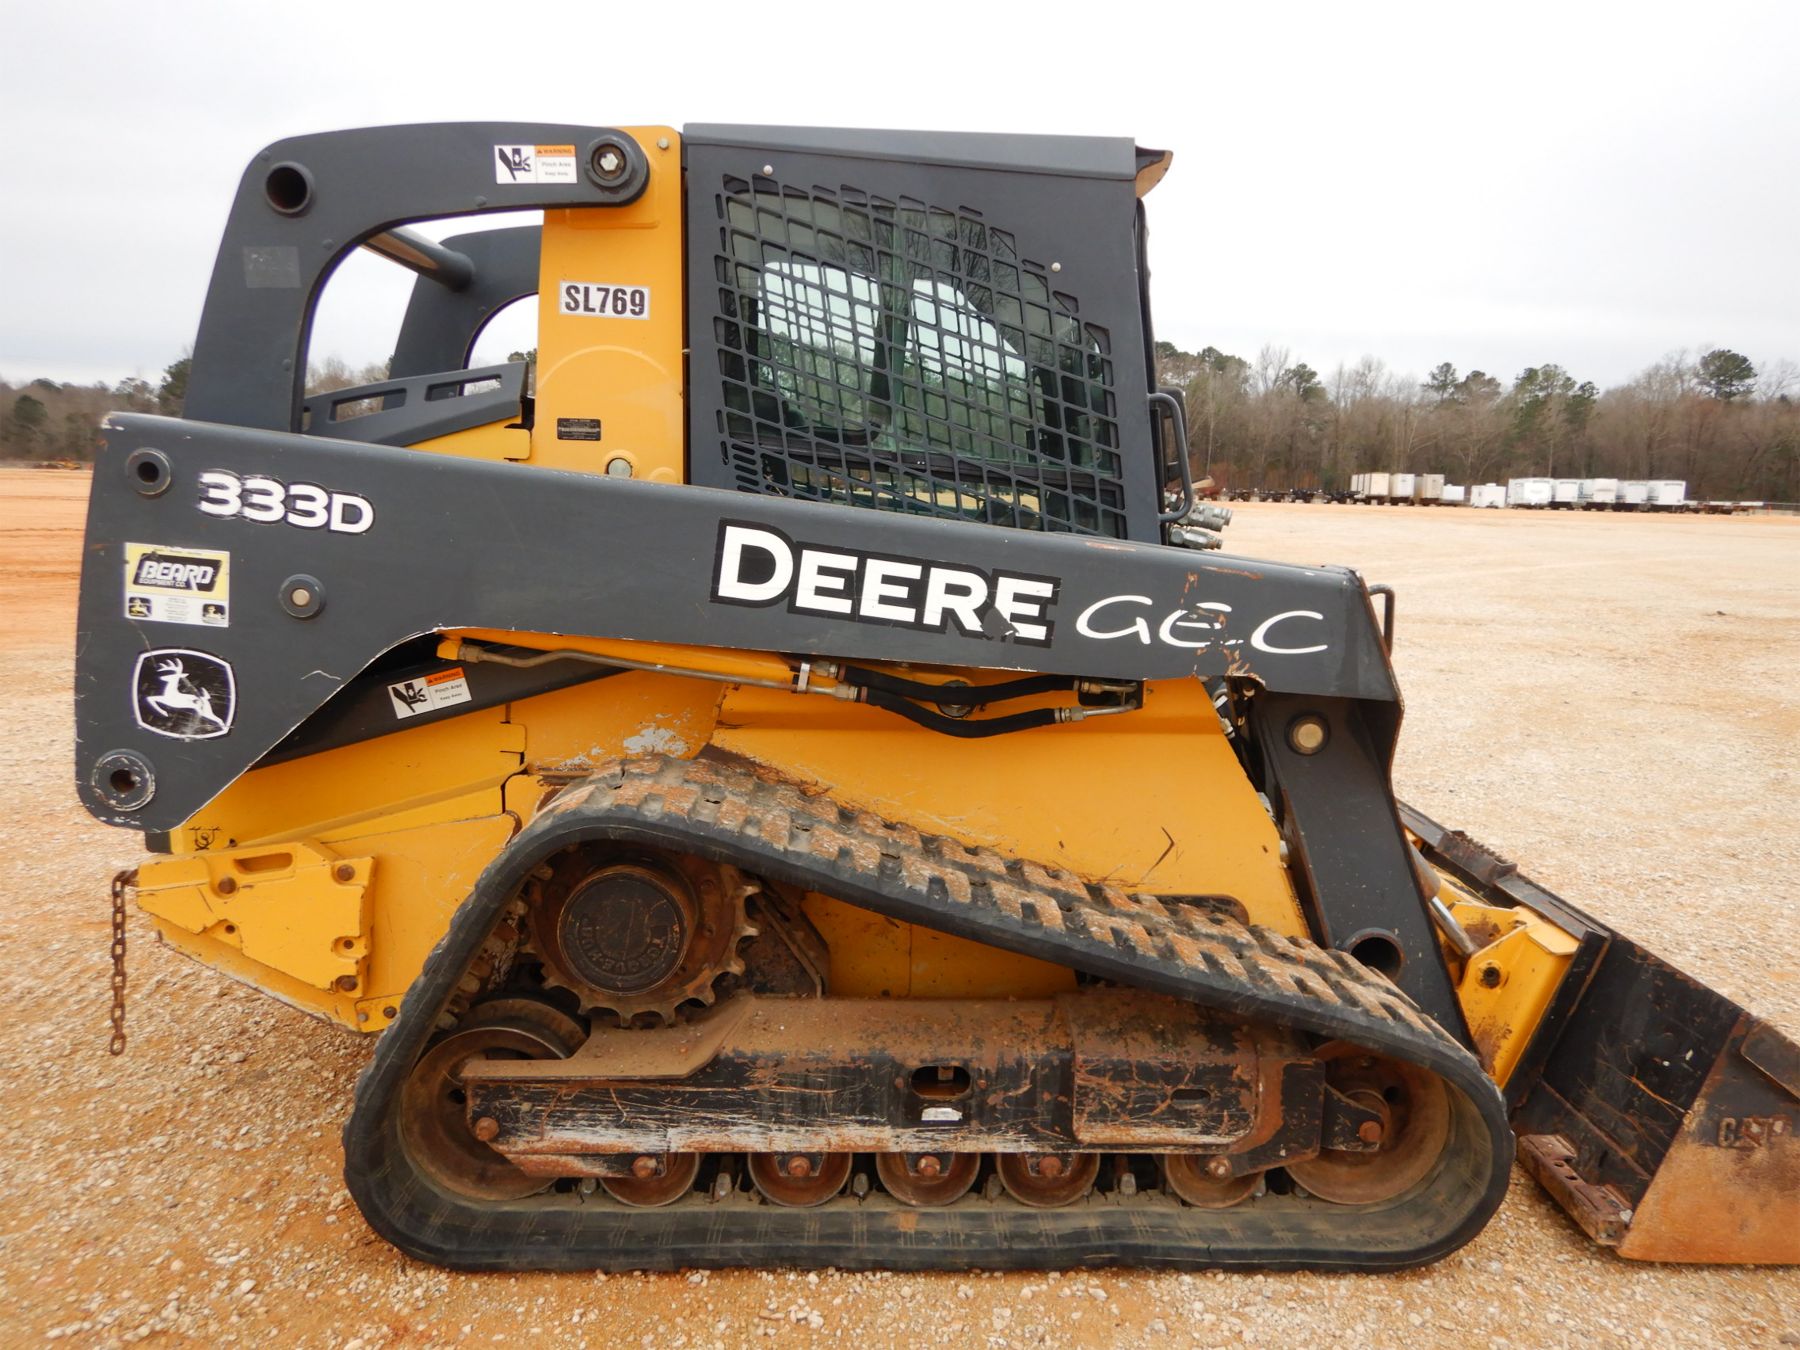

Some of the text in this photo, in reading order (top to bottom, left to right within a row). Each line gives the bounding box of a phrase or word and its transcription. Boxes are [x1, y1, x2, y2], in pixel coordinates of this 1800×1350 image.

[564, 285, 645, 316] SL769
[198, 471, 375, 534] 333D
[140, 561, 214, 590] BEARD
[718, 525, 1054, 641] DEERE
